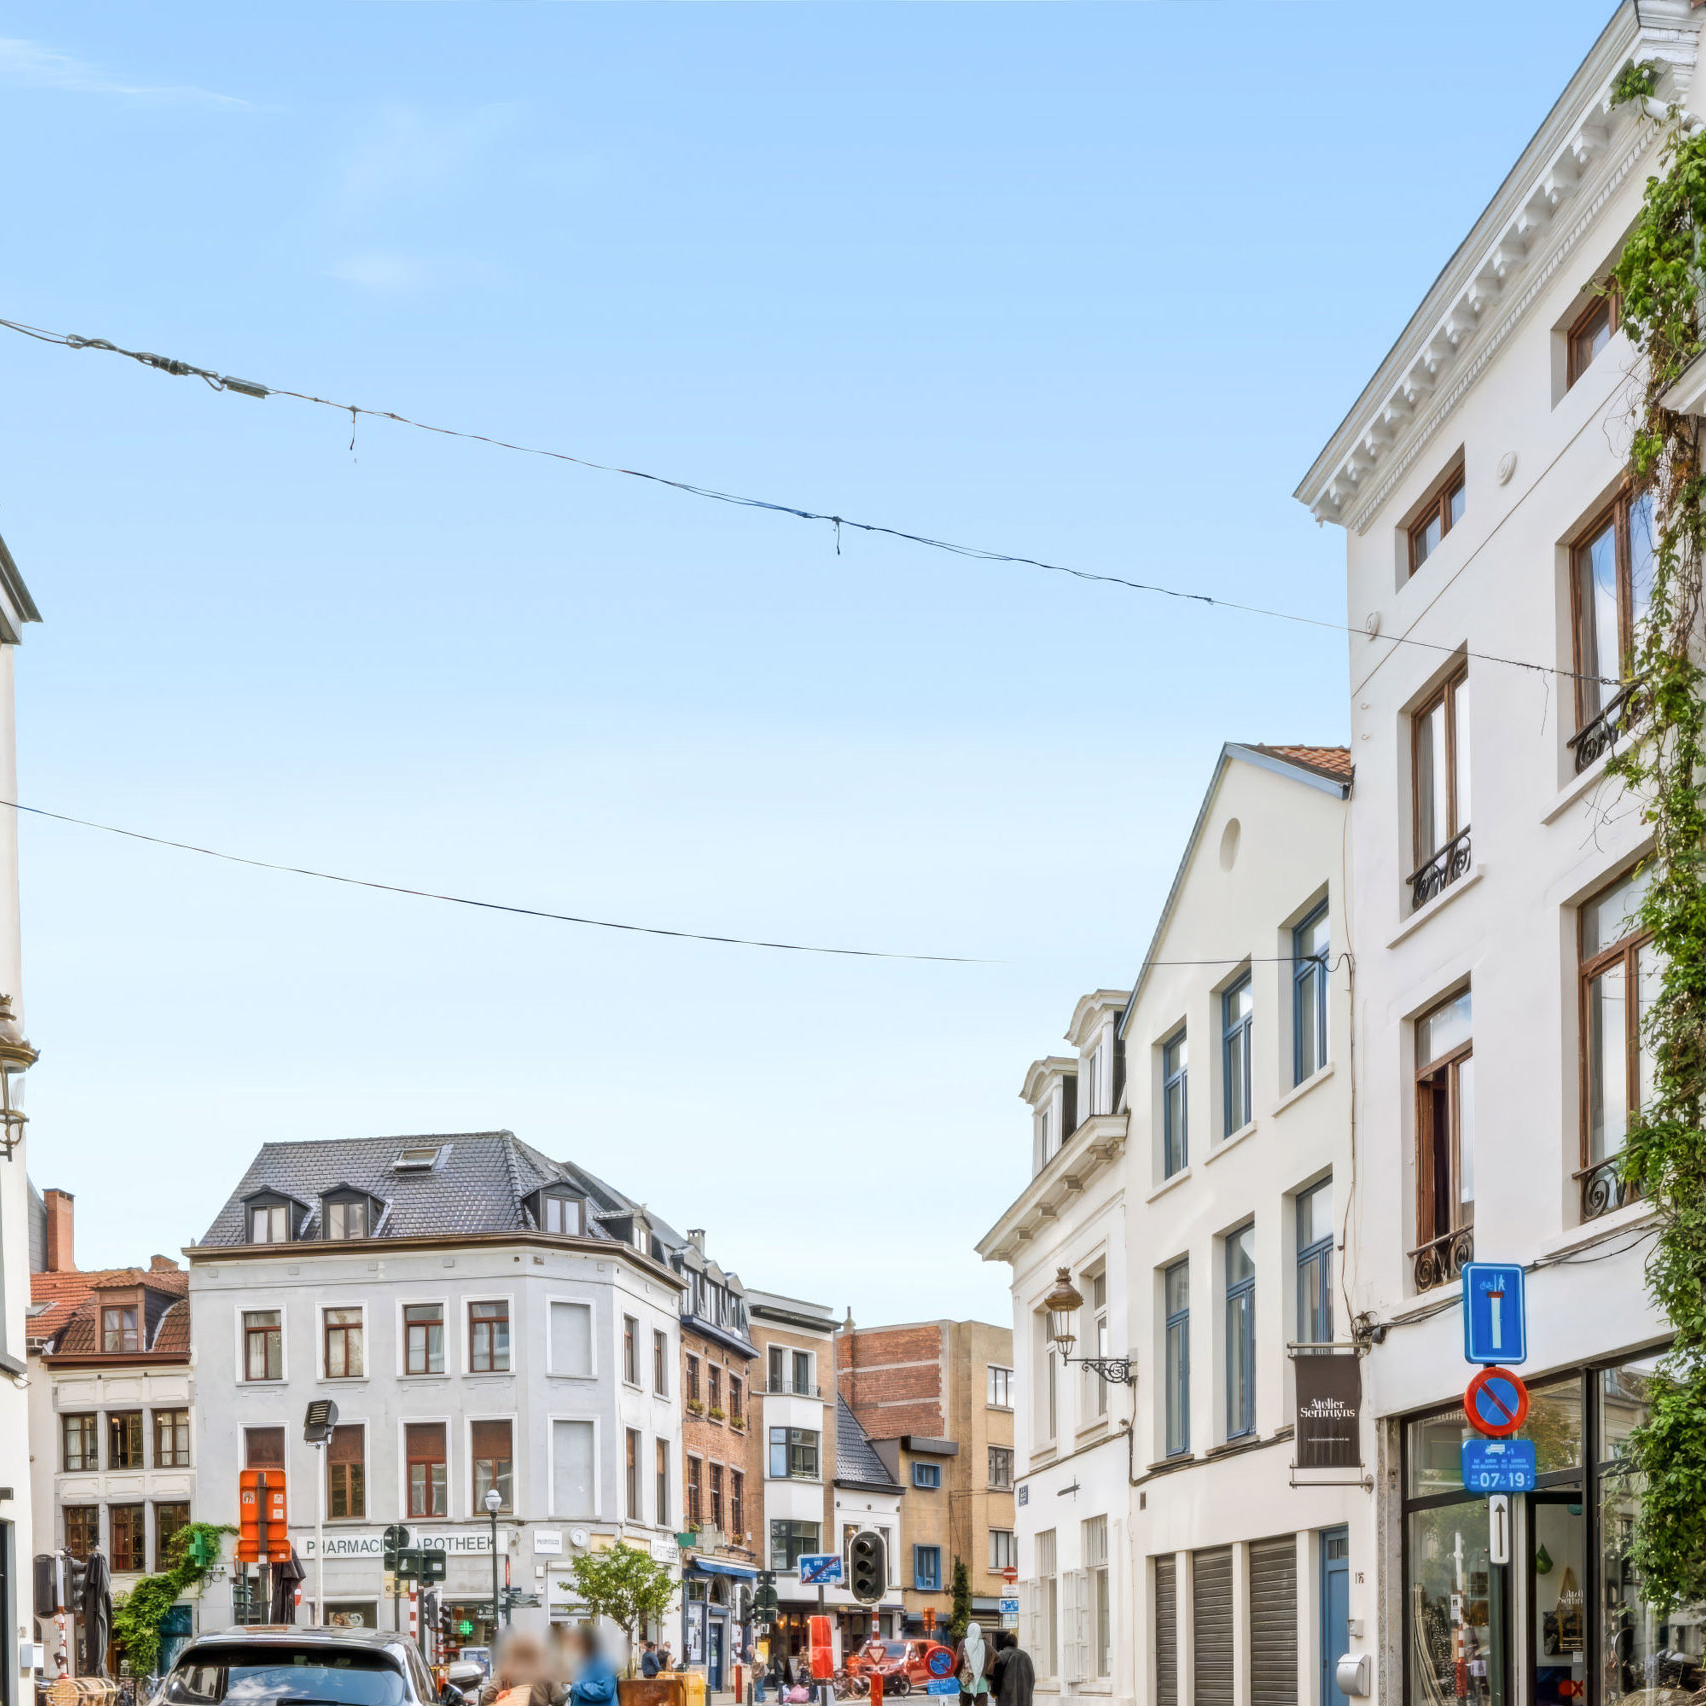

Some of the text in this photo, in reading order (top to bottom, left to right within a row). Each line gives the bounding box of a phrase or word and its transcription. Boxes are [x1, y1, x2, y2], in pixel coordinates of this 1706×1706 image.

[1310, 1397, 1345, 1410] Atelier
[1300, 1407, 1356, 1420] Serbruyns
[1480, 1472, 1501, 1488] 07
[1509, 1472, 1525, 1487] 19
[306, 1538, 389, 1555] PARMACI
